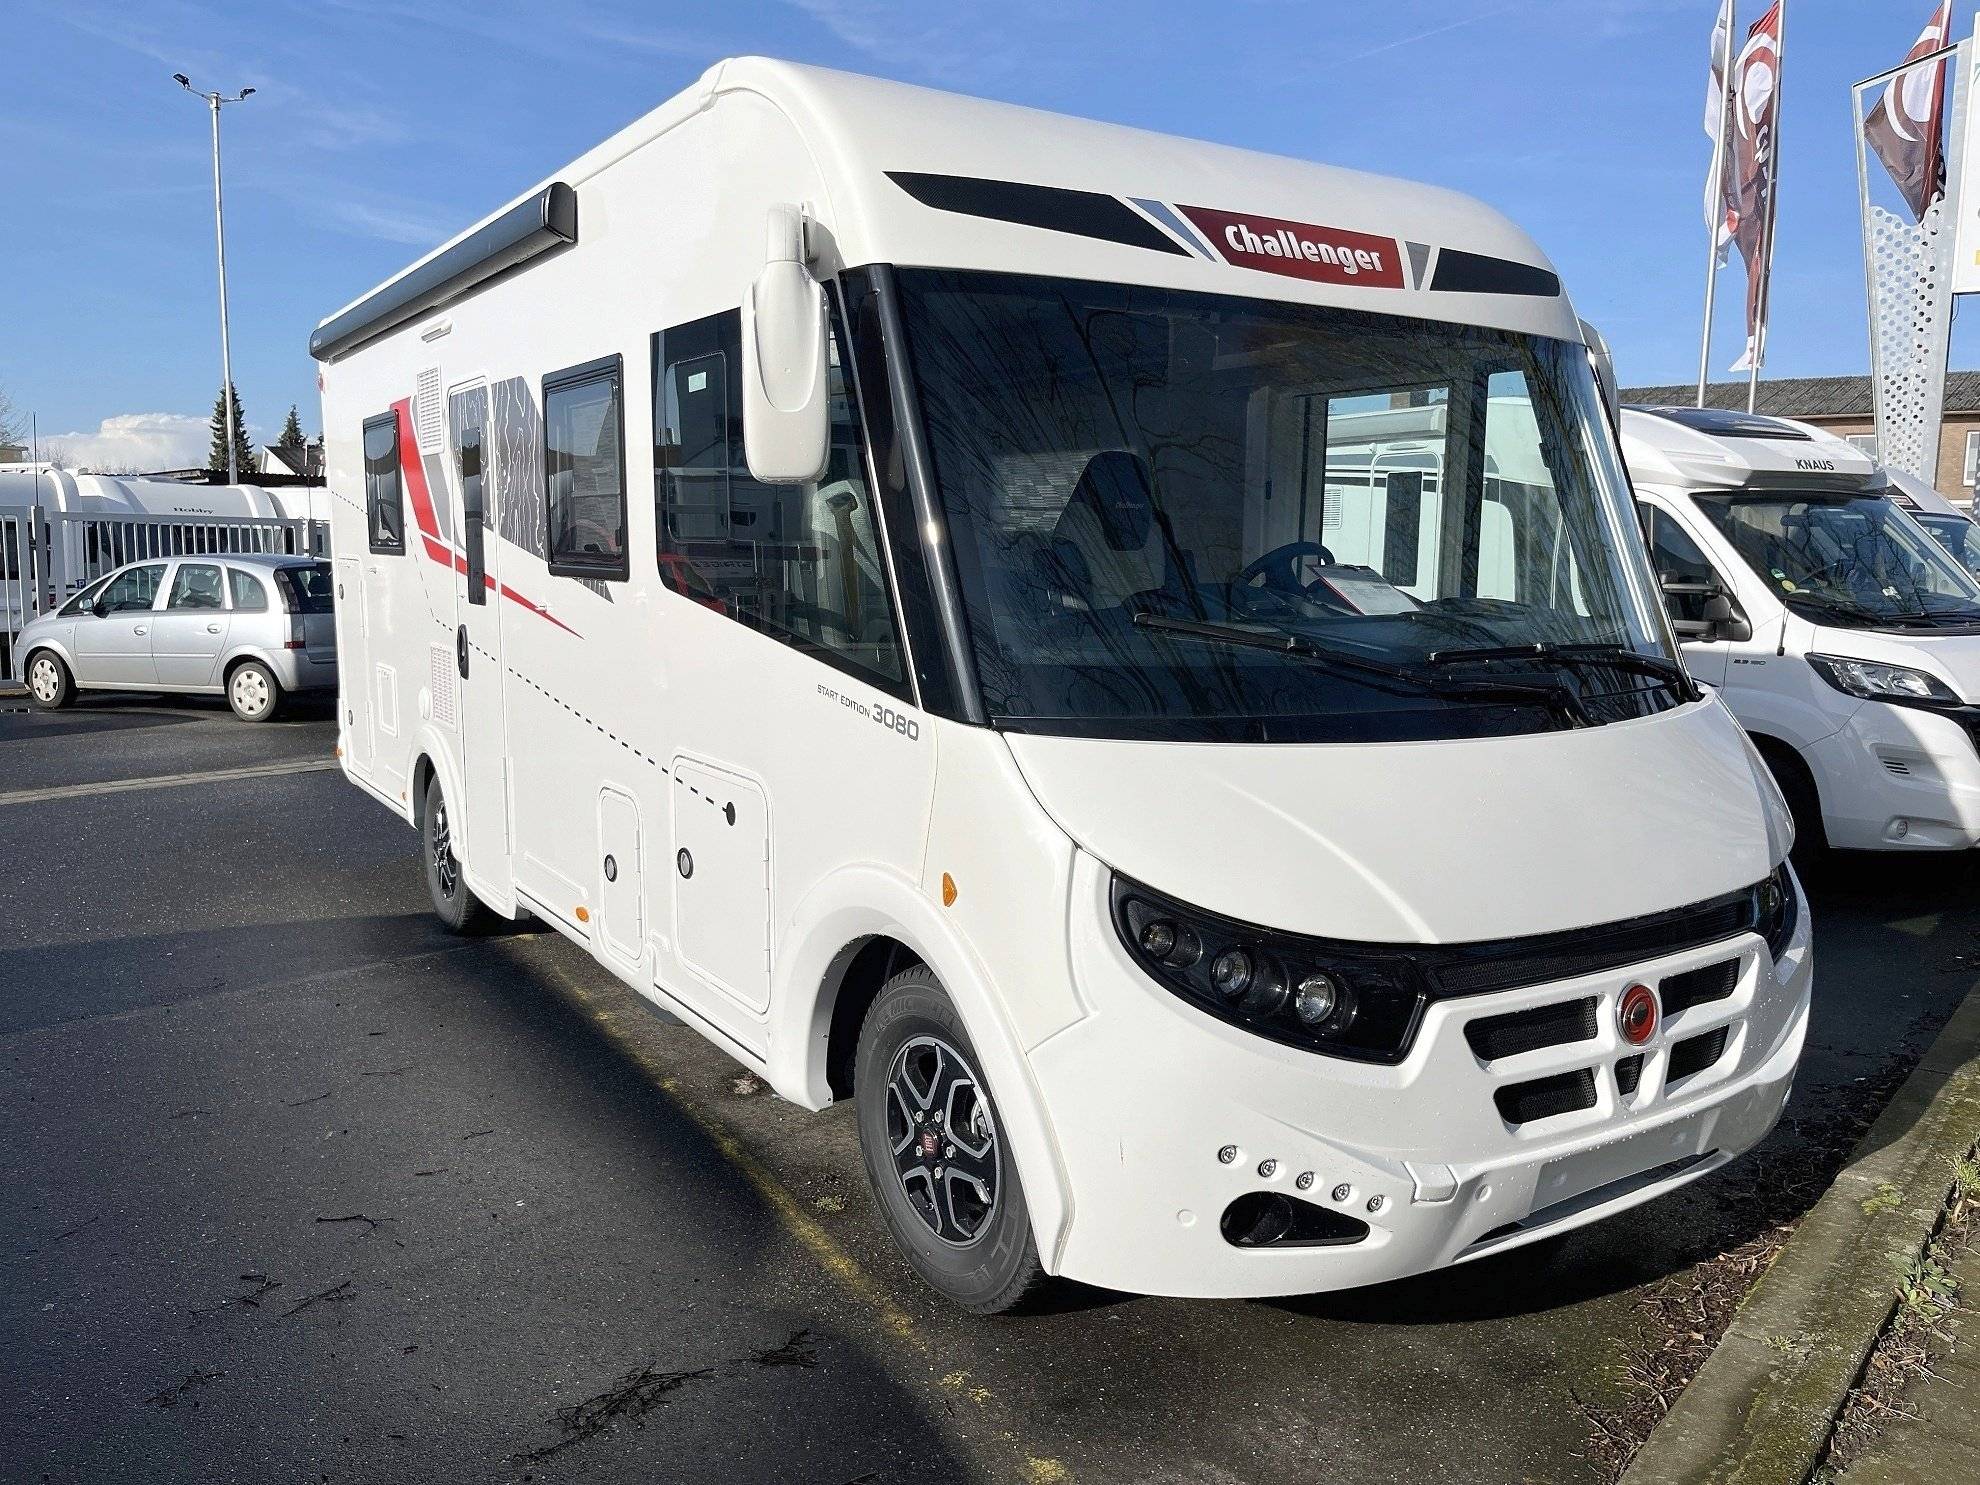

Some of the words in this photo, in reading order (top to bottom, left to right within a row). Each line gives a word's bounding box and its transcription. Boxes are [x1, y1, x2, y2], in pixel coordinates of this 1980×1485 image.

[1224, 224, 1384, 275] Challenger
[1795, 459, 1835, 471] KNAUS
[817, 684, 839, 701] START
[840, 695, 871, 718] EDITION
[872, 703, 919, 741] 3080
[924, 1133, 934, 1153] FIAT
